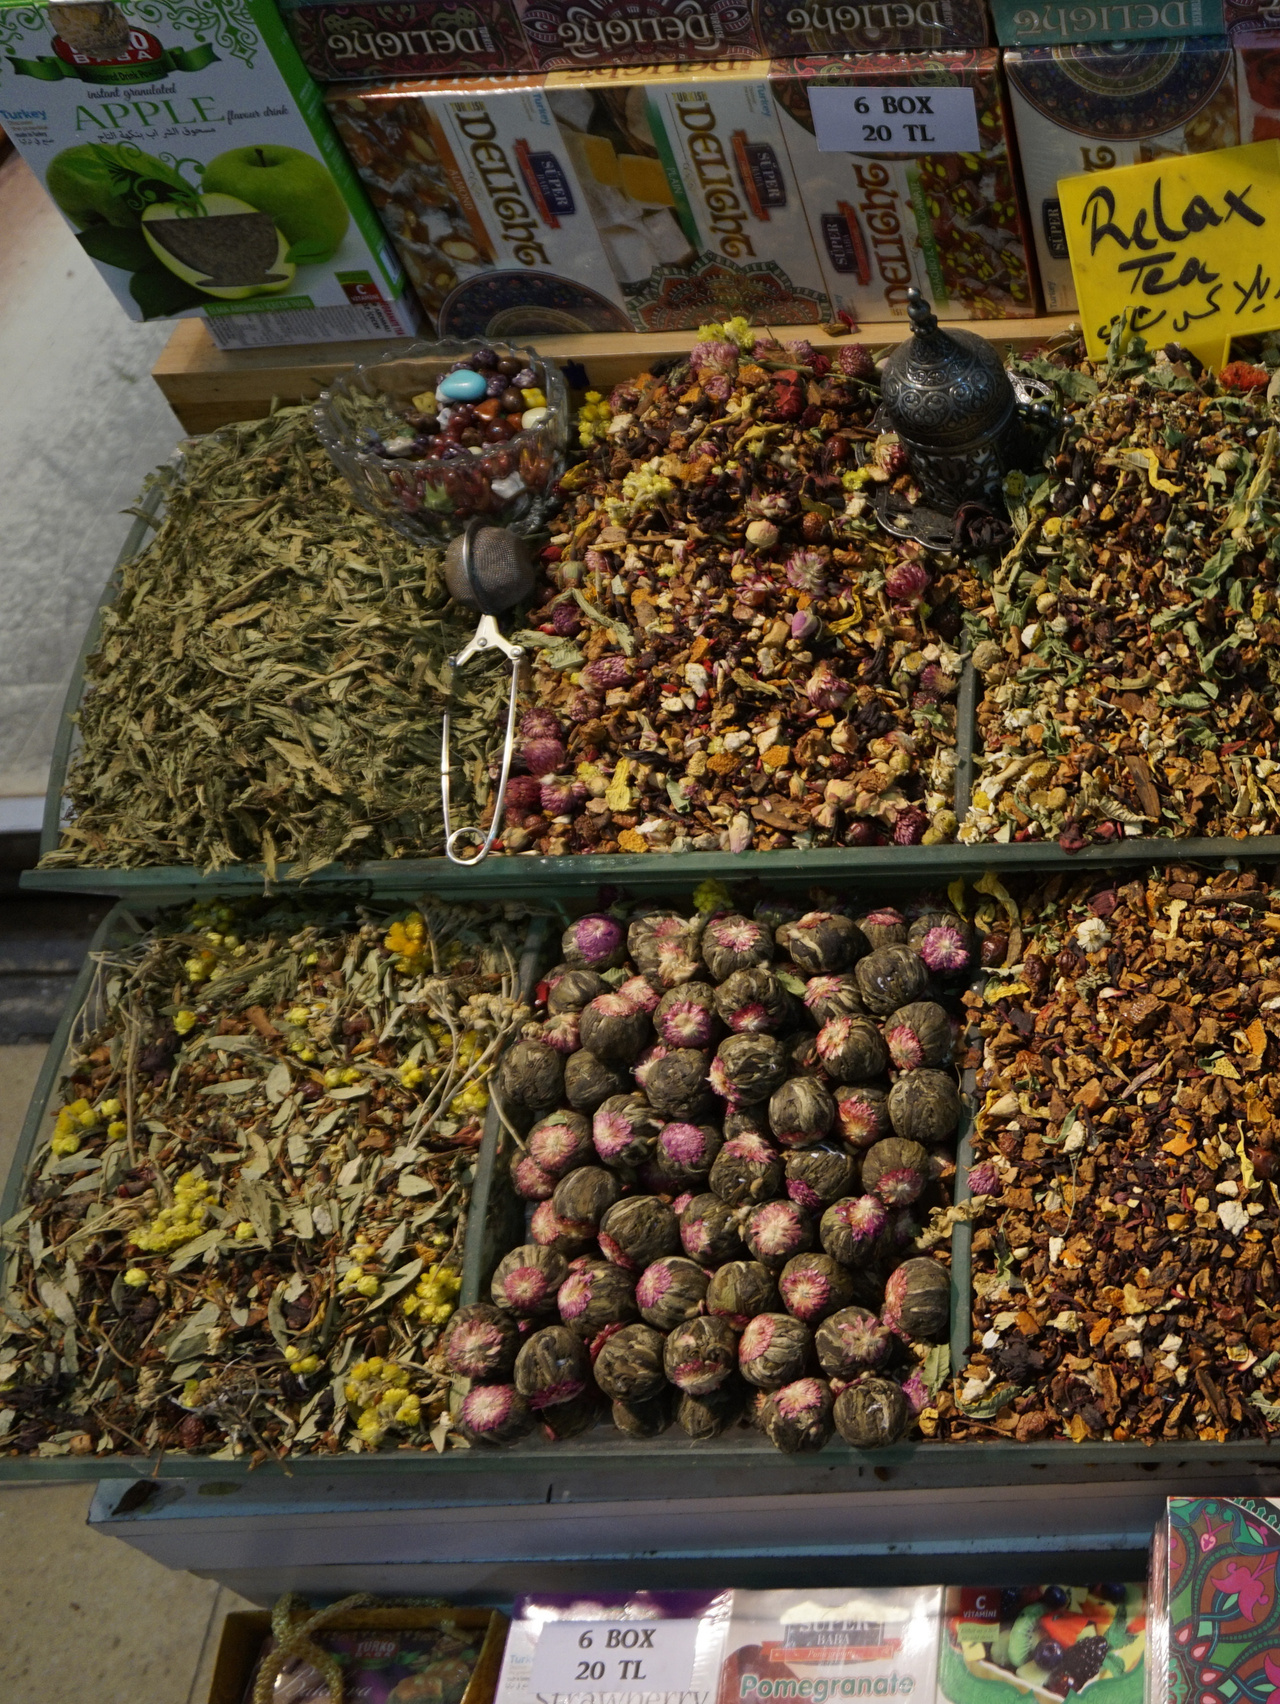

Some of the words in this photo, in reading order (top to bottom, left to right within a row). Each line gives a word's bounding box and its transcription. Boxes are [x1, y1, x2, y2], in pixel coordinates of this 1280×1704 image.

[73, 50, 153, 64] BBA
[87, 86, 120, 99] instant
[124, 83, 176, 100] granulated
[75, 96, 225, 131] APPLE
[263, 106, 289, 118] drink
[854, 96, 870, 114] 6
[881, 95, 934, 114] BOX
[862, 124, 892, 142] 20
[903, 124, 935, 142] TL
[449, 169, 474, 211] ALMOND
[666, 167, 684, 195] PLAIN
[1082, 177, 1265, 256] Relax
[1118, 252, 1220, 295] Tea
[975, 1595, 986, 1610] C
[578, 1629, 593, 1649] 6
[604, 1628, 657, 1649] BOX
[817, 1633, 850, 1645] BABA
[575, 1660, 605, 1680] 20
[618, 1659, 647, 1680] TL
[740, 1671, 915, 1702] Pomegranate
